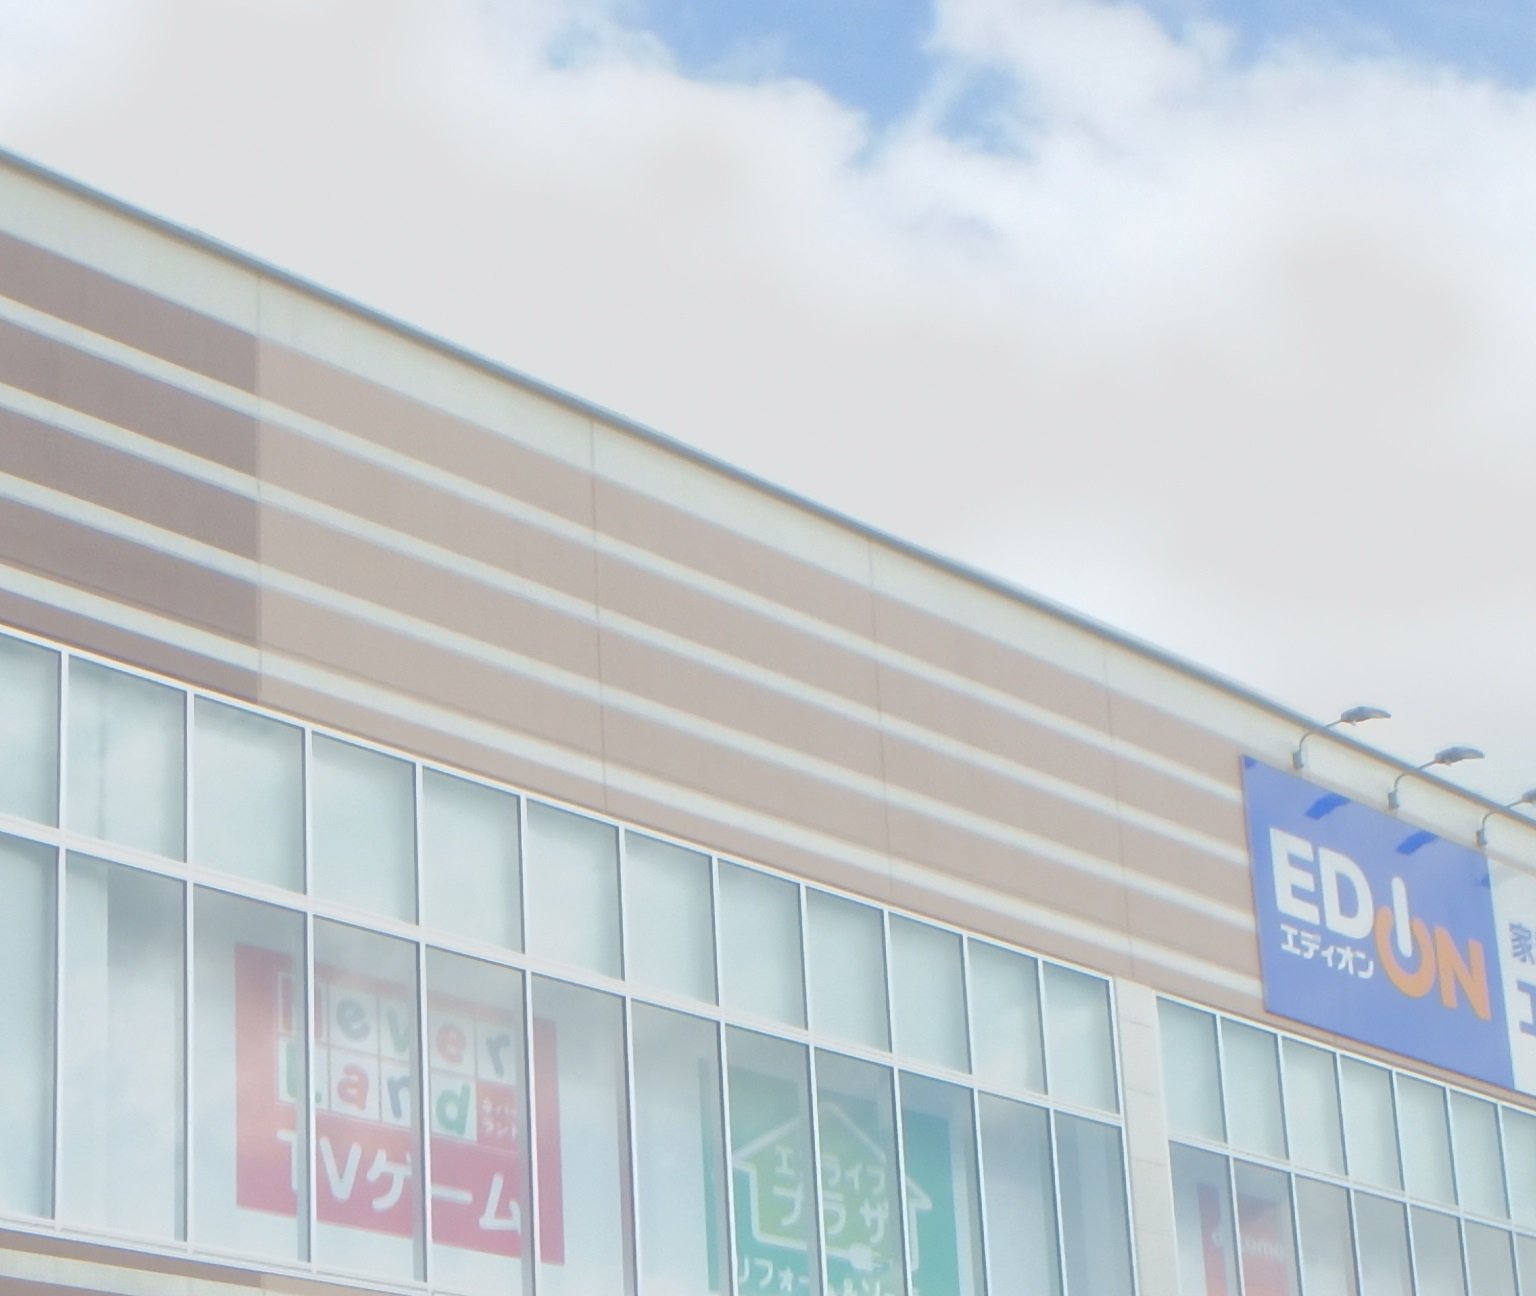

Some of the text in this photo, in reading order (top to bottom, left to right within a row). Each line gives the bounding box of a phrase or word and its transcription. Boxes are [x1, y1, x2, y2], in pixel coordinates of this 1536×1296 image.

[1268, 827, 1492, 1021] EDION
[1279, 923, 1375, 979] エディオン
